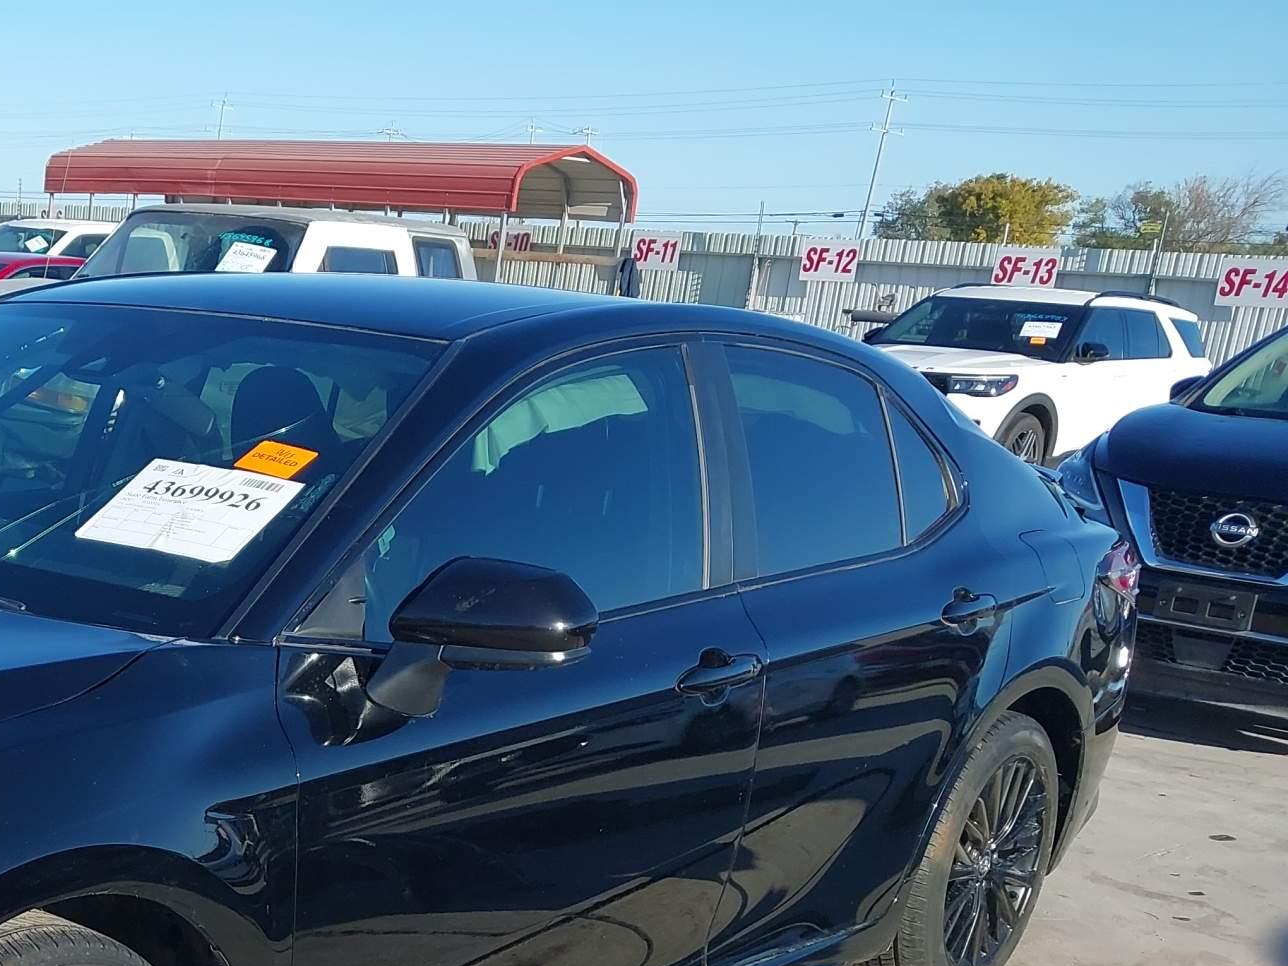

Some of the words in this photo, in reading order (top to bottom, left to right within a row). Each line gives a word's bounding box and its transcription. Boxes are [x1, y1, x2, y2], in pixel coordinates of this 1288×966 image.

[489, 230, 530, 252] S-10
[634, 238, 678, 264] SF-11
[802, 247, 858, 274] SF-12
[994, 256, 1058, 285] SF-13
[1219, 267, 1288, 299] SF-14
[252, 451, 299, 468] DETAILED
[143, 479, 269, 512] 43699926
[1210, 522, 1259, 537] NISSAN
